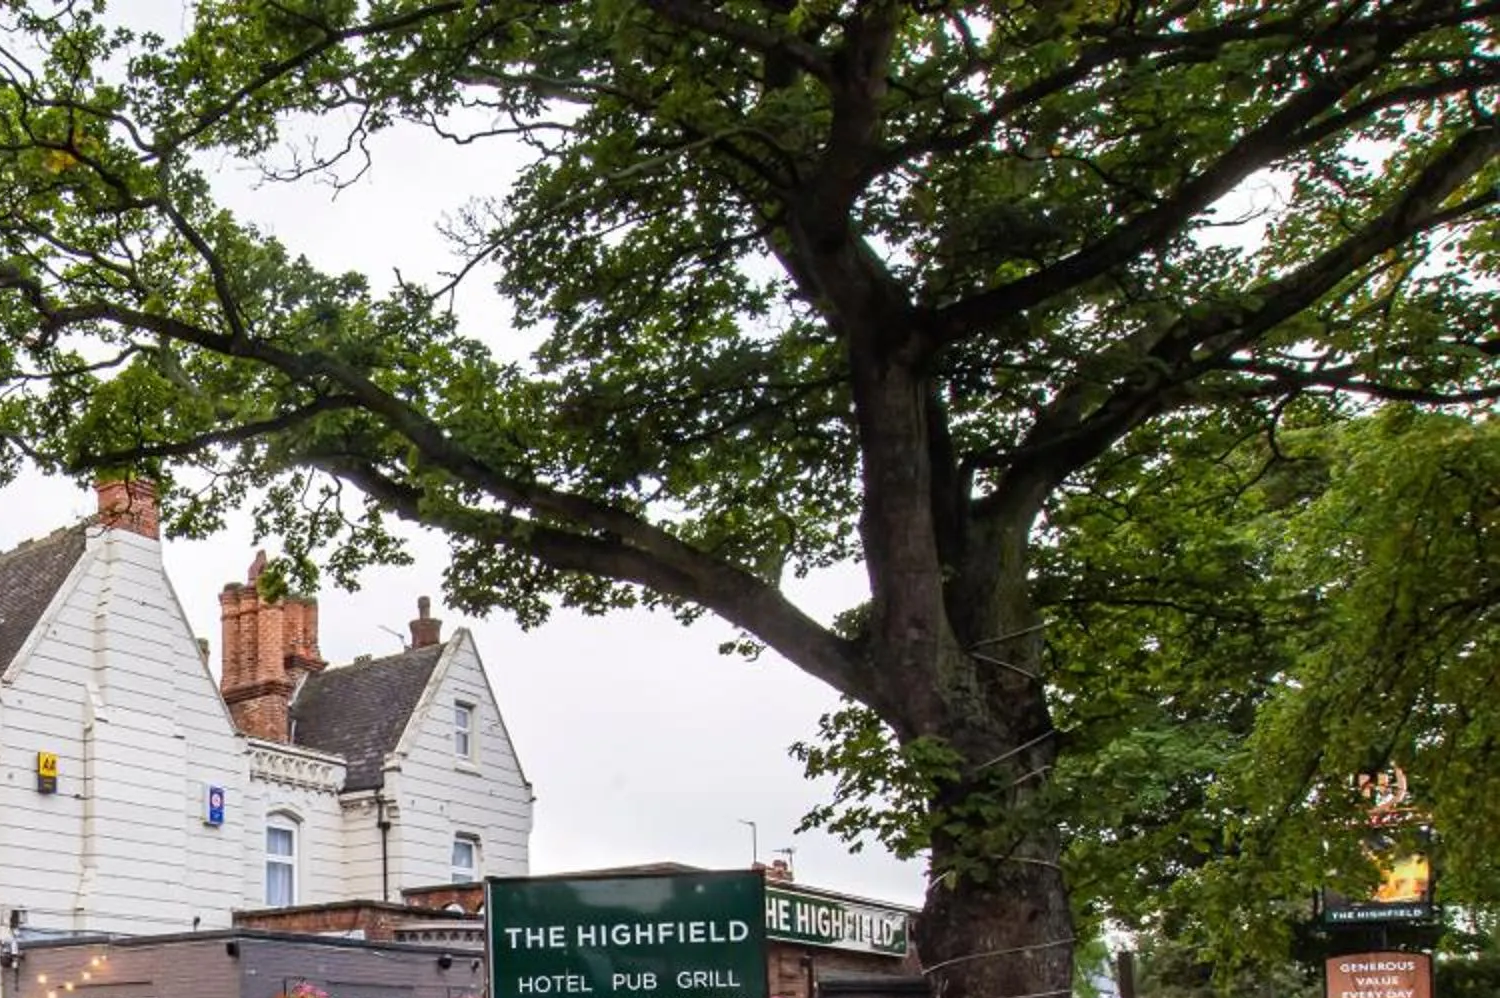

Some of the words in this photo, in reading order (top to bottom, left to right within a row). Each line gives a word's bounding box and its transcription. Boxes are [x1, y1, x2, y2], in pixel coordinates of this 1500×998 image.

[765, 896, 791, 932] HE
[795, 901, 894, 947] HIGHFIELD
[505, 926, 566, 949] THE
[577, 920, 749, 947] HIGHFIELD
[1339, 961, 1416, 973] GENEROUS
[518, 974, 593, 994] HOTEL
[612, 972, 658, 991] PUB
[676, 969, 741, 989] GRILL
[1355, 975, 1399, 986] VALUE
[1387, 989, 1414, 998] DAY
